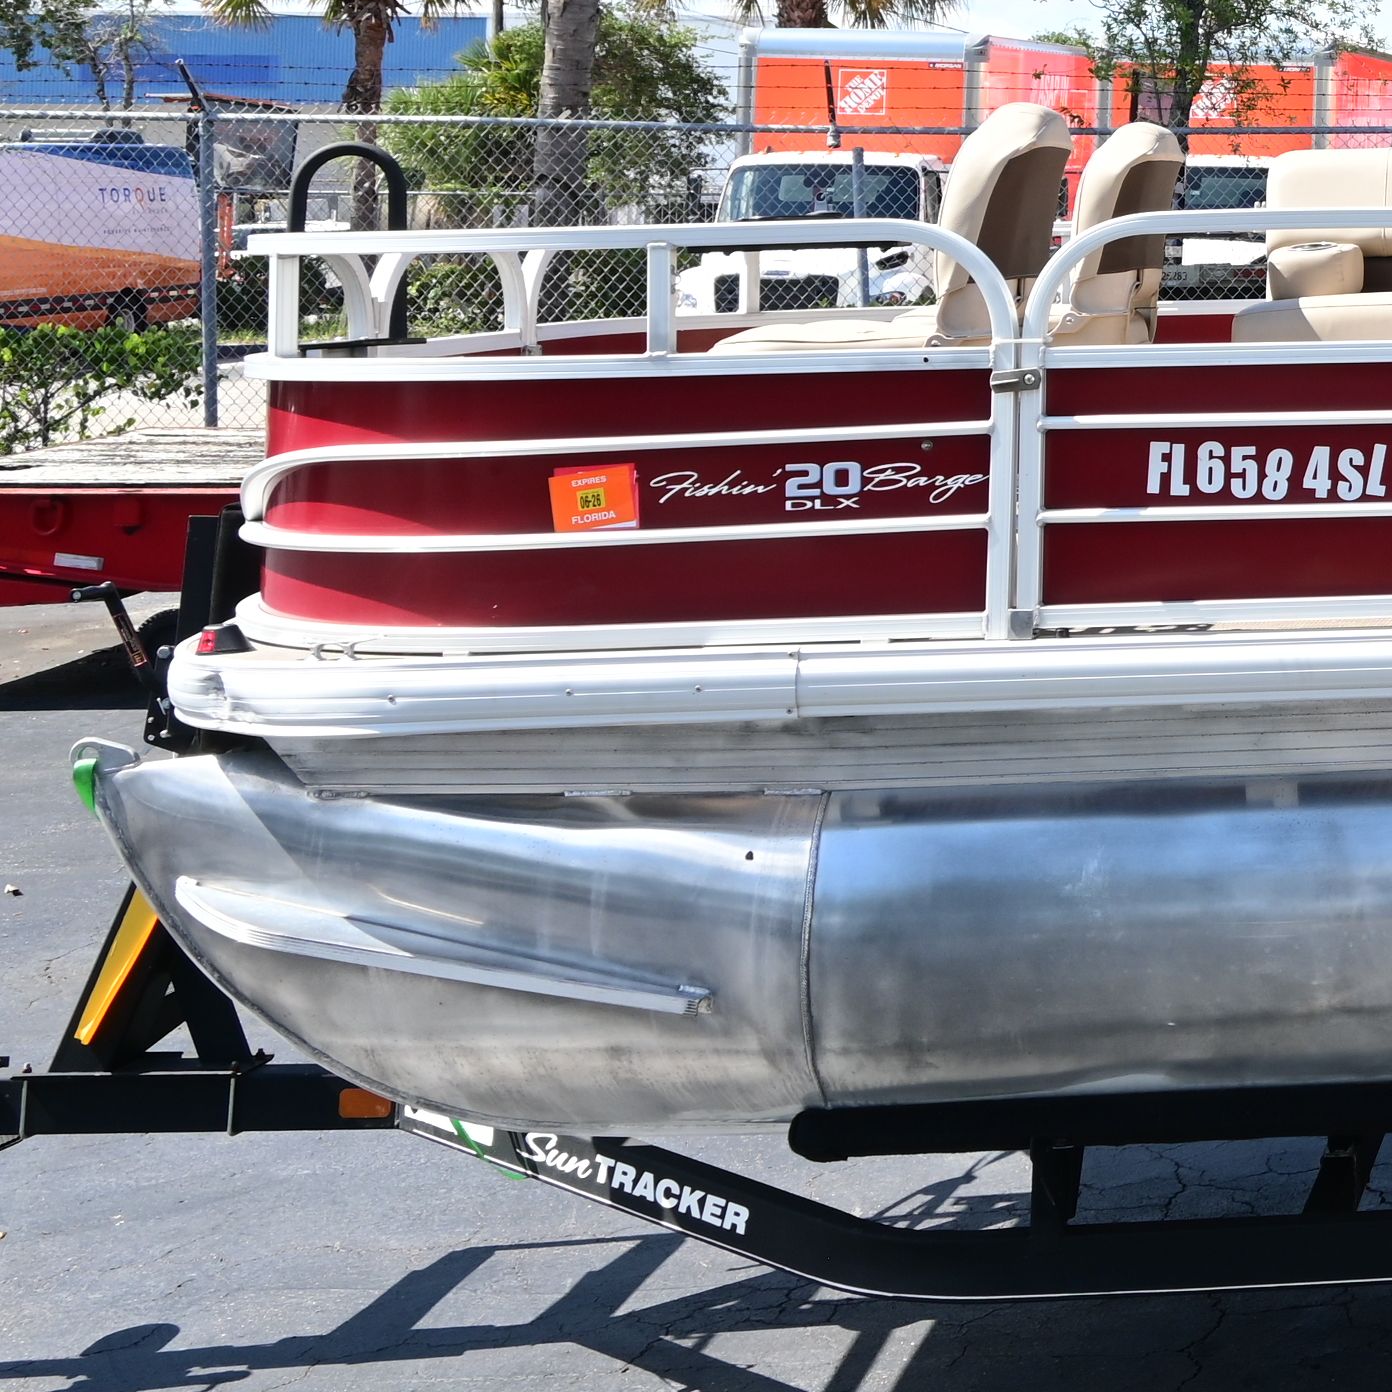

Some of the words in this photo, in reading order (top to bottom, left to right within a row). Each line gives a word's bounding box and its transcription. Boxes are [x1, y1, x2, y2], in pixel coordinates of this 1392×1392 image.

[839, 70, 885, 114] HOME
[98, 187, 167, 209] TORQUE
[571, 475, 607, 487] EXPIRES
[785, 461, 862, 498] 20
[863, 462, 991, 504] Barge
[785, 497, 860, 511] DLX
[571, 511, 616, 525] FLORIDA
[516, 1132, 593, 1179] Sun
[595, 1153, 750, 1236] TRACKER
